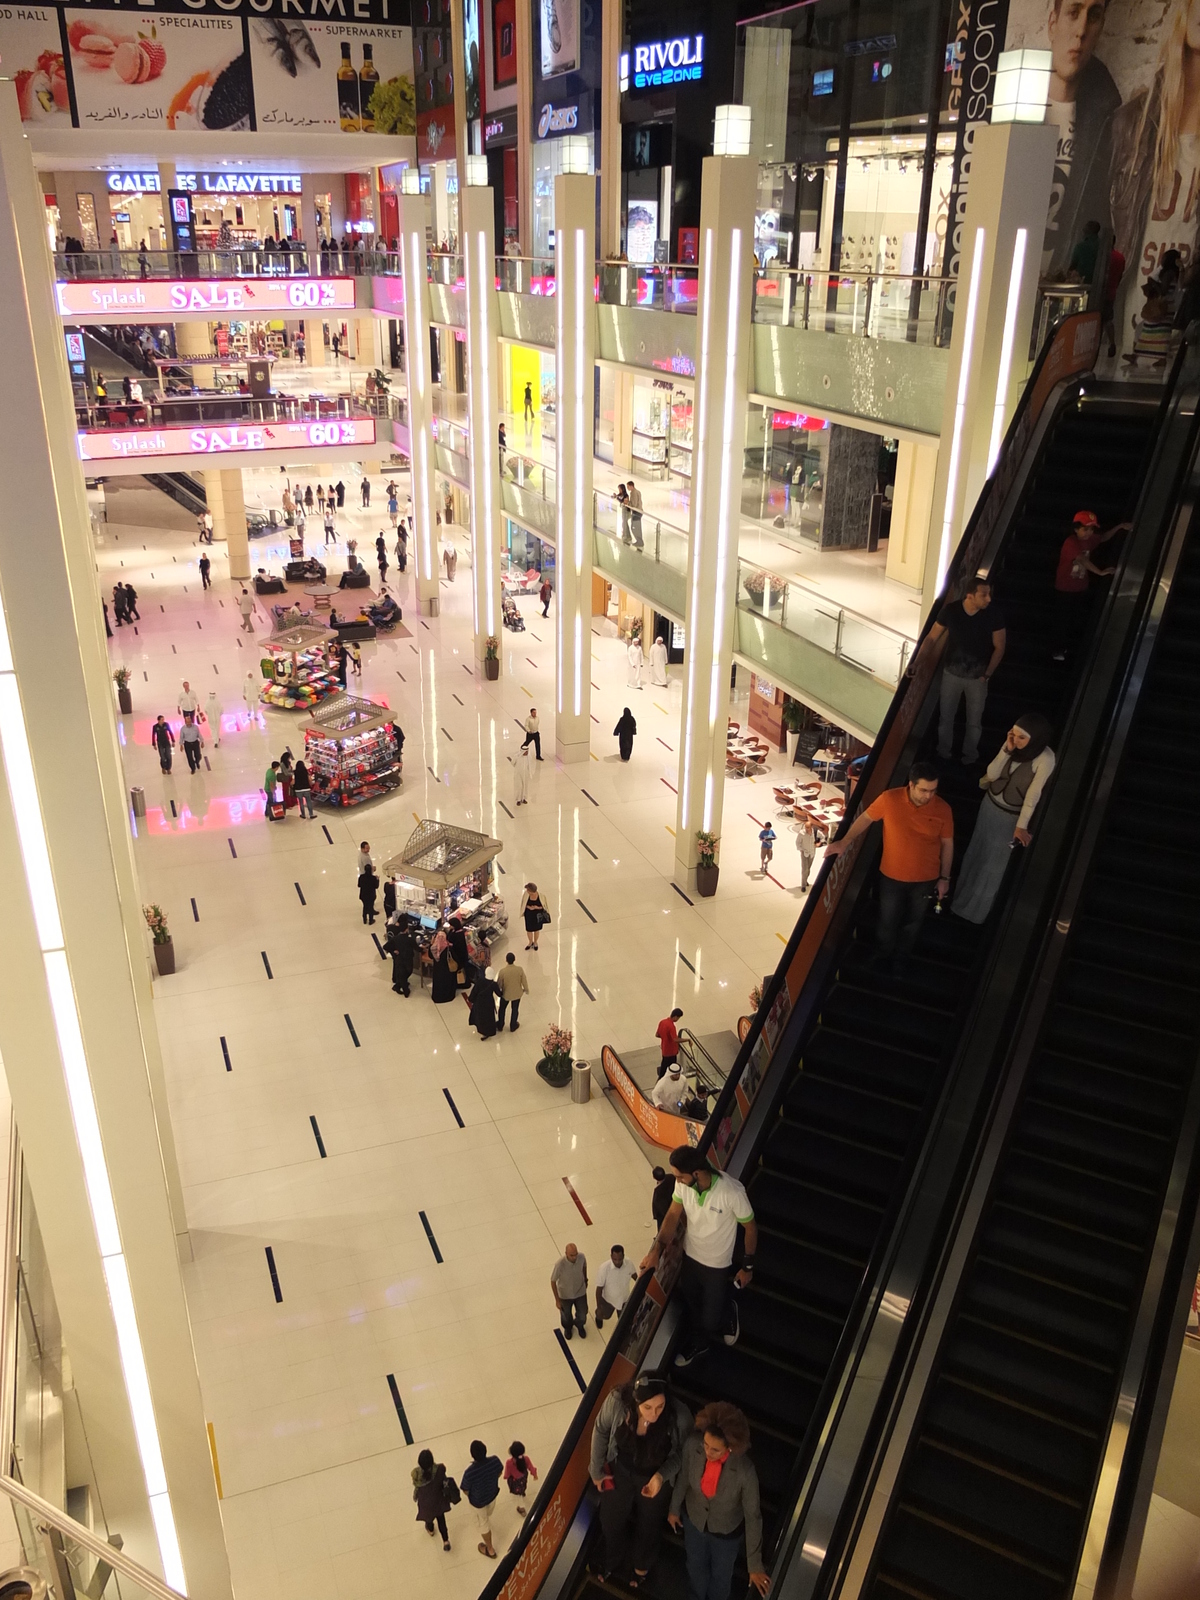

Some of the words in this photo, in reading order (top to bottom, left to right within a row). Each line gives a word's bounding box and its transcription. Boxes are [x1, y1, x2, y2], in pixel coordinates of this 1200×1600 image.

[17, 10, 49, 21] HALL
[159, 17, 233, 30] SPECIALITIES
[326, 26, 403, 39] SUPERMARKET
[635, 36, 704, 73] RIVOLI
[966, 1, 999, 119] soon
[108, 174, 197, 192] GALEES
[203, 174, 302, 193] LAFAYETTE
[92, 287, 146, 310] Splash
[171, 284, 244, 309] SALE
[112, 434, 166, 455] Splash
[191, 427, 264, 453] SALE
[530, 1494, 562, 1547] OPEN
